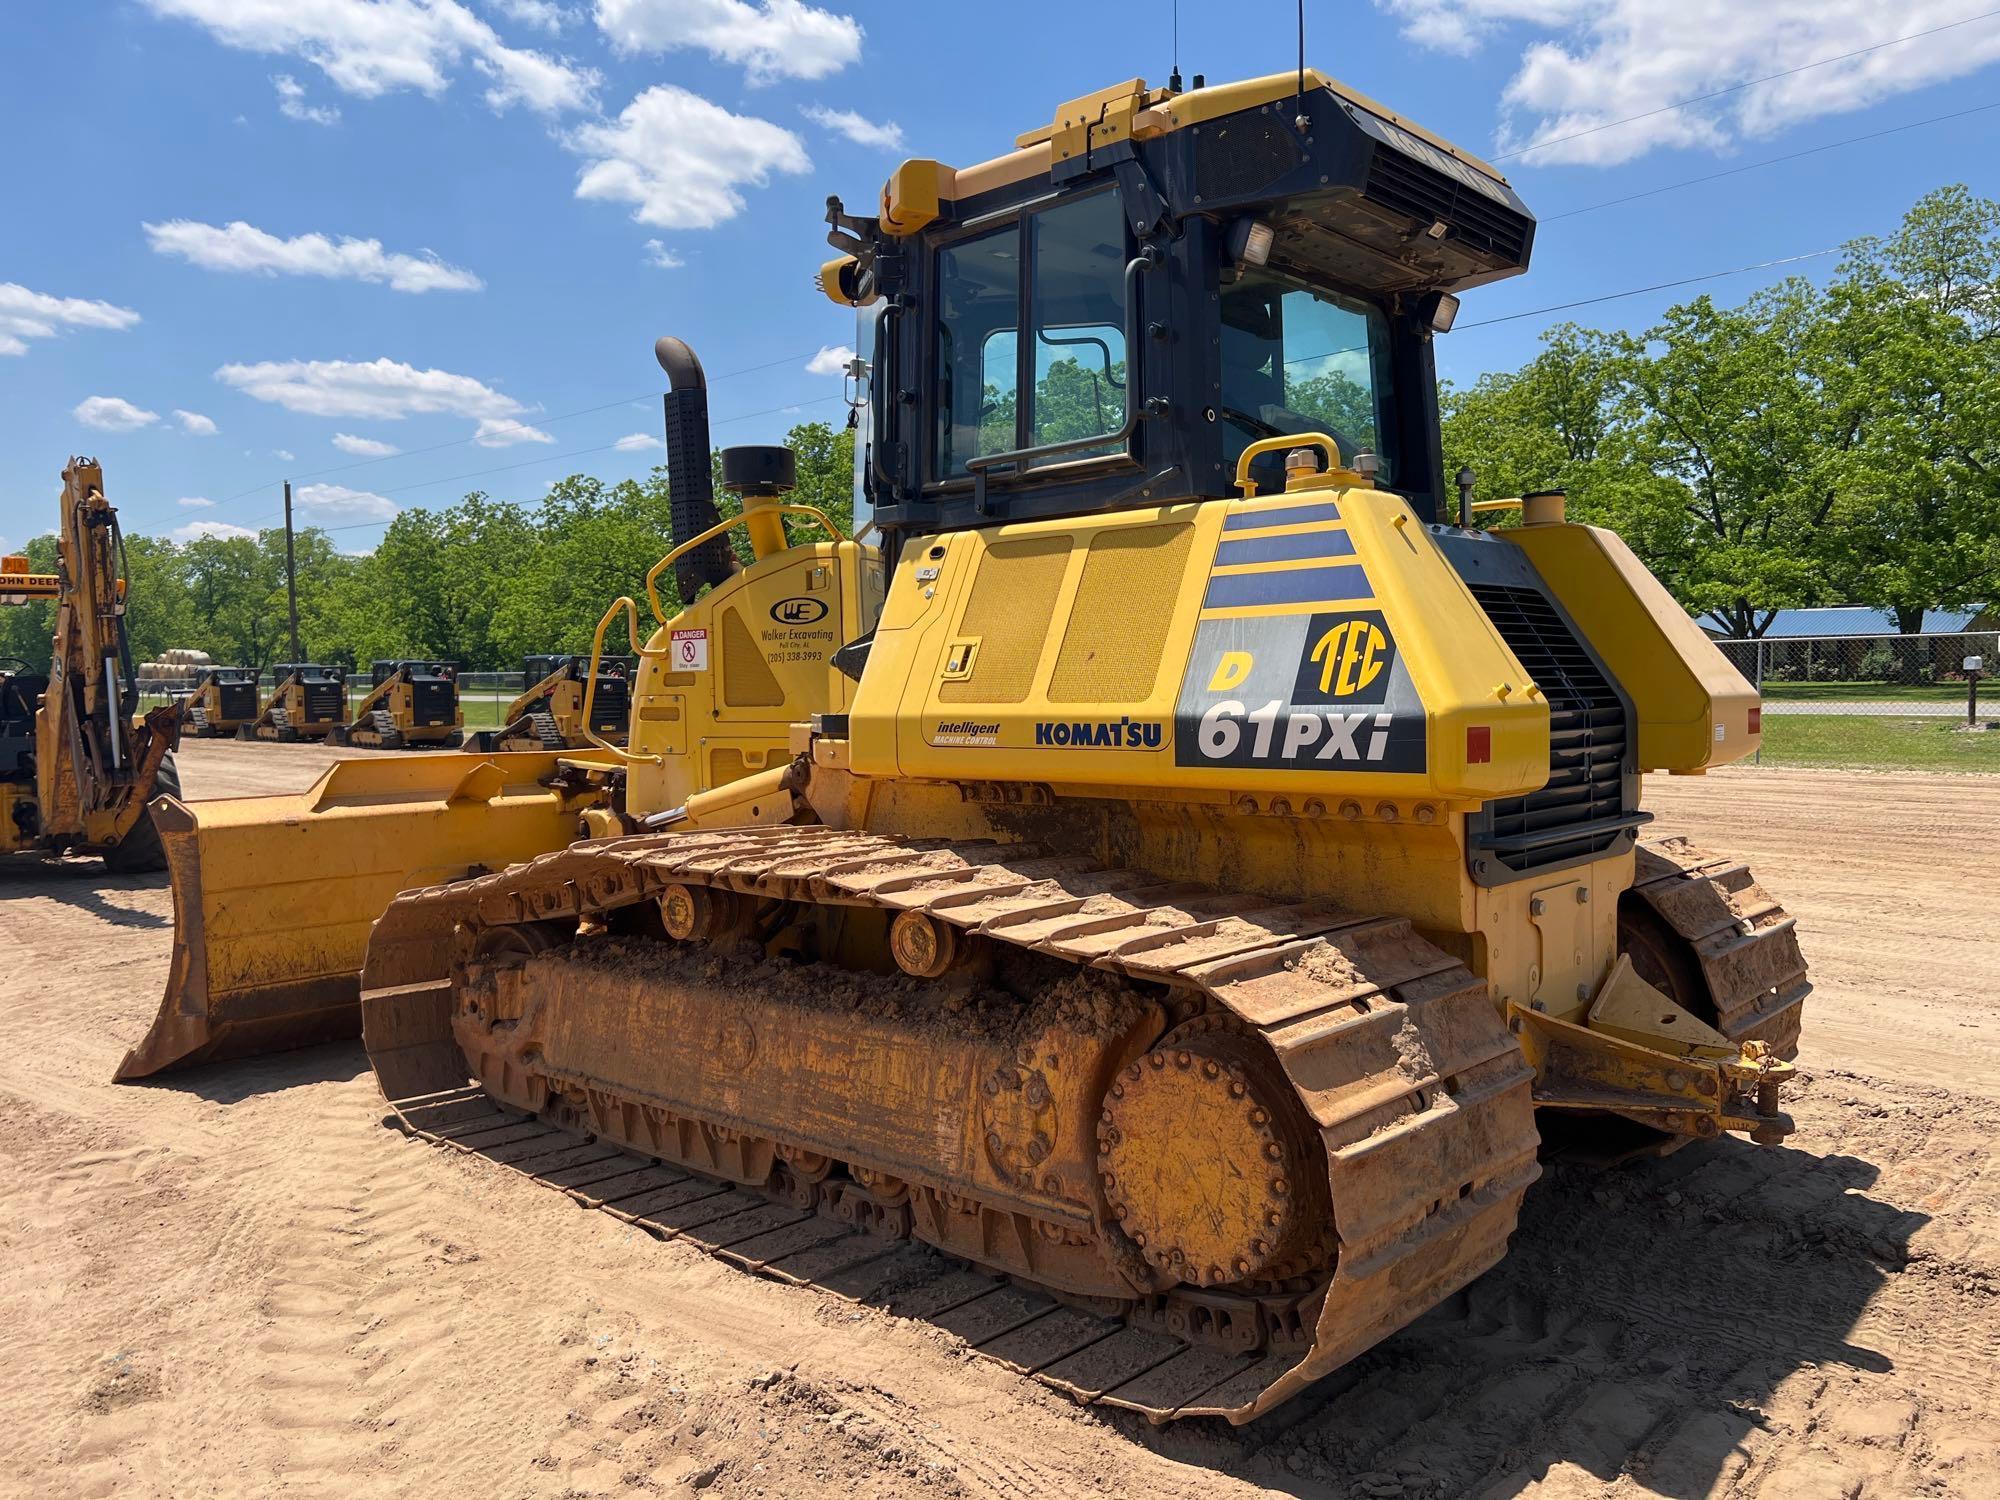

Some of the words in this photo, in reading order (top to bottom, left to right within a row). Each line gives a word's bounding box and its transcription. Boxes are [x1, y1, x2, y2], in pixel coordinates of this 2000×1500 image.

[679, 630, 704, 639] DANGER
[761, 629, 786, 641] Walker
[789, 628, 833, 642] Excavating
[767, 652, 785, 664] (205)
[786, 651, 823, 662] 338-3993
[937, 721, 1001, 736] intelligent
[1035, 715, 1162, 748] KOMATSU
[933, 735, 965, 744] MACHINE
[965, 736, 996, 746] CONTROL
